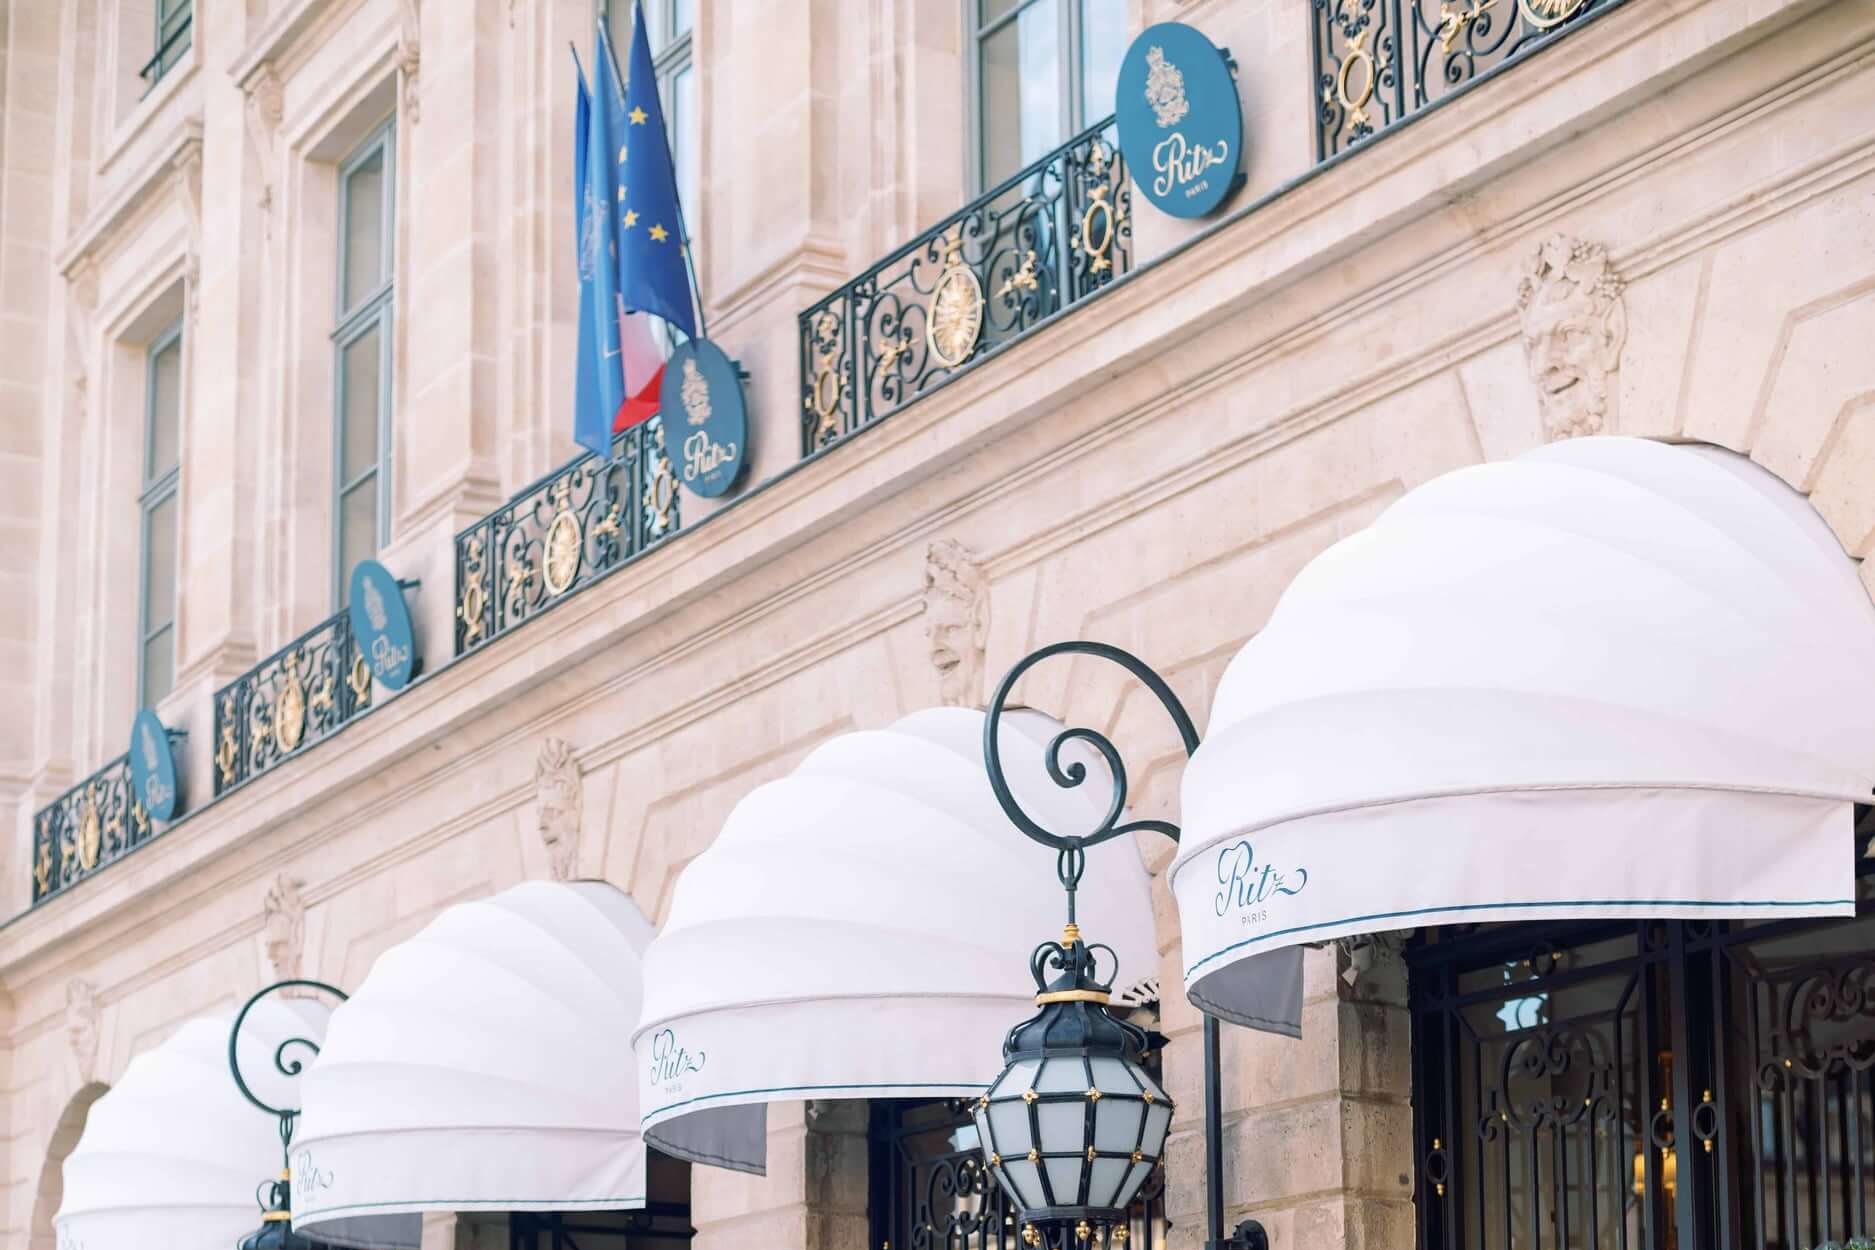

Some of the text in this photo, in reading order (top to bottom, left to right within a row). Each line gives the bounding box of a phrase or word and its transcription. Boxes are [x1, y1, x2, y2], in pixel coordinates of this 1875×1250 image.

[1152, 132, 1228, 197] Ritz
[1216, 840, 1308, 917] Ritz
[1241, 910, 1268, 926] PARIS
[650, 1028, 706, 1086] Ritz
